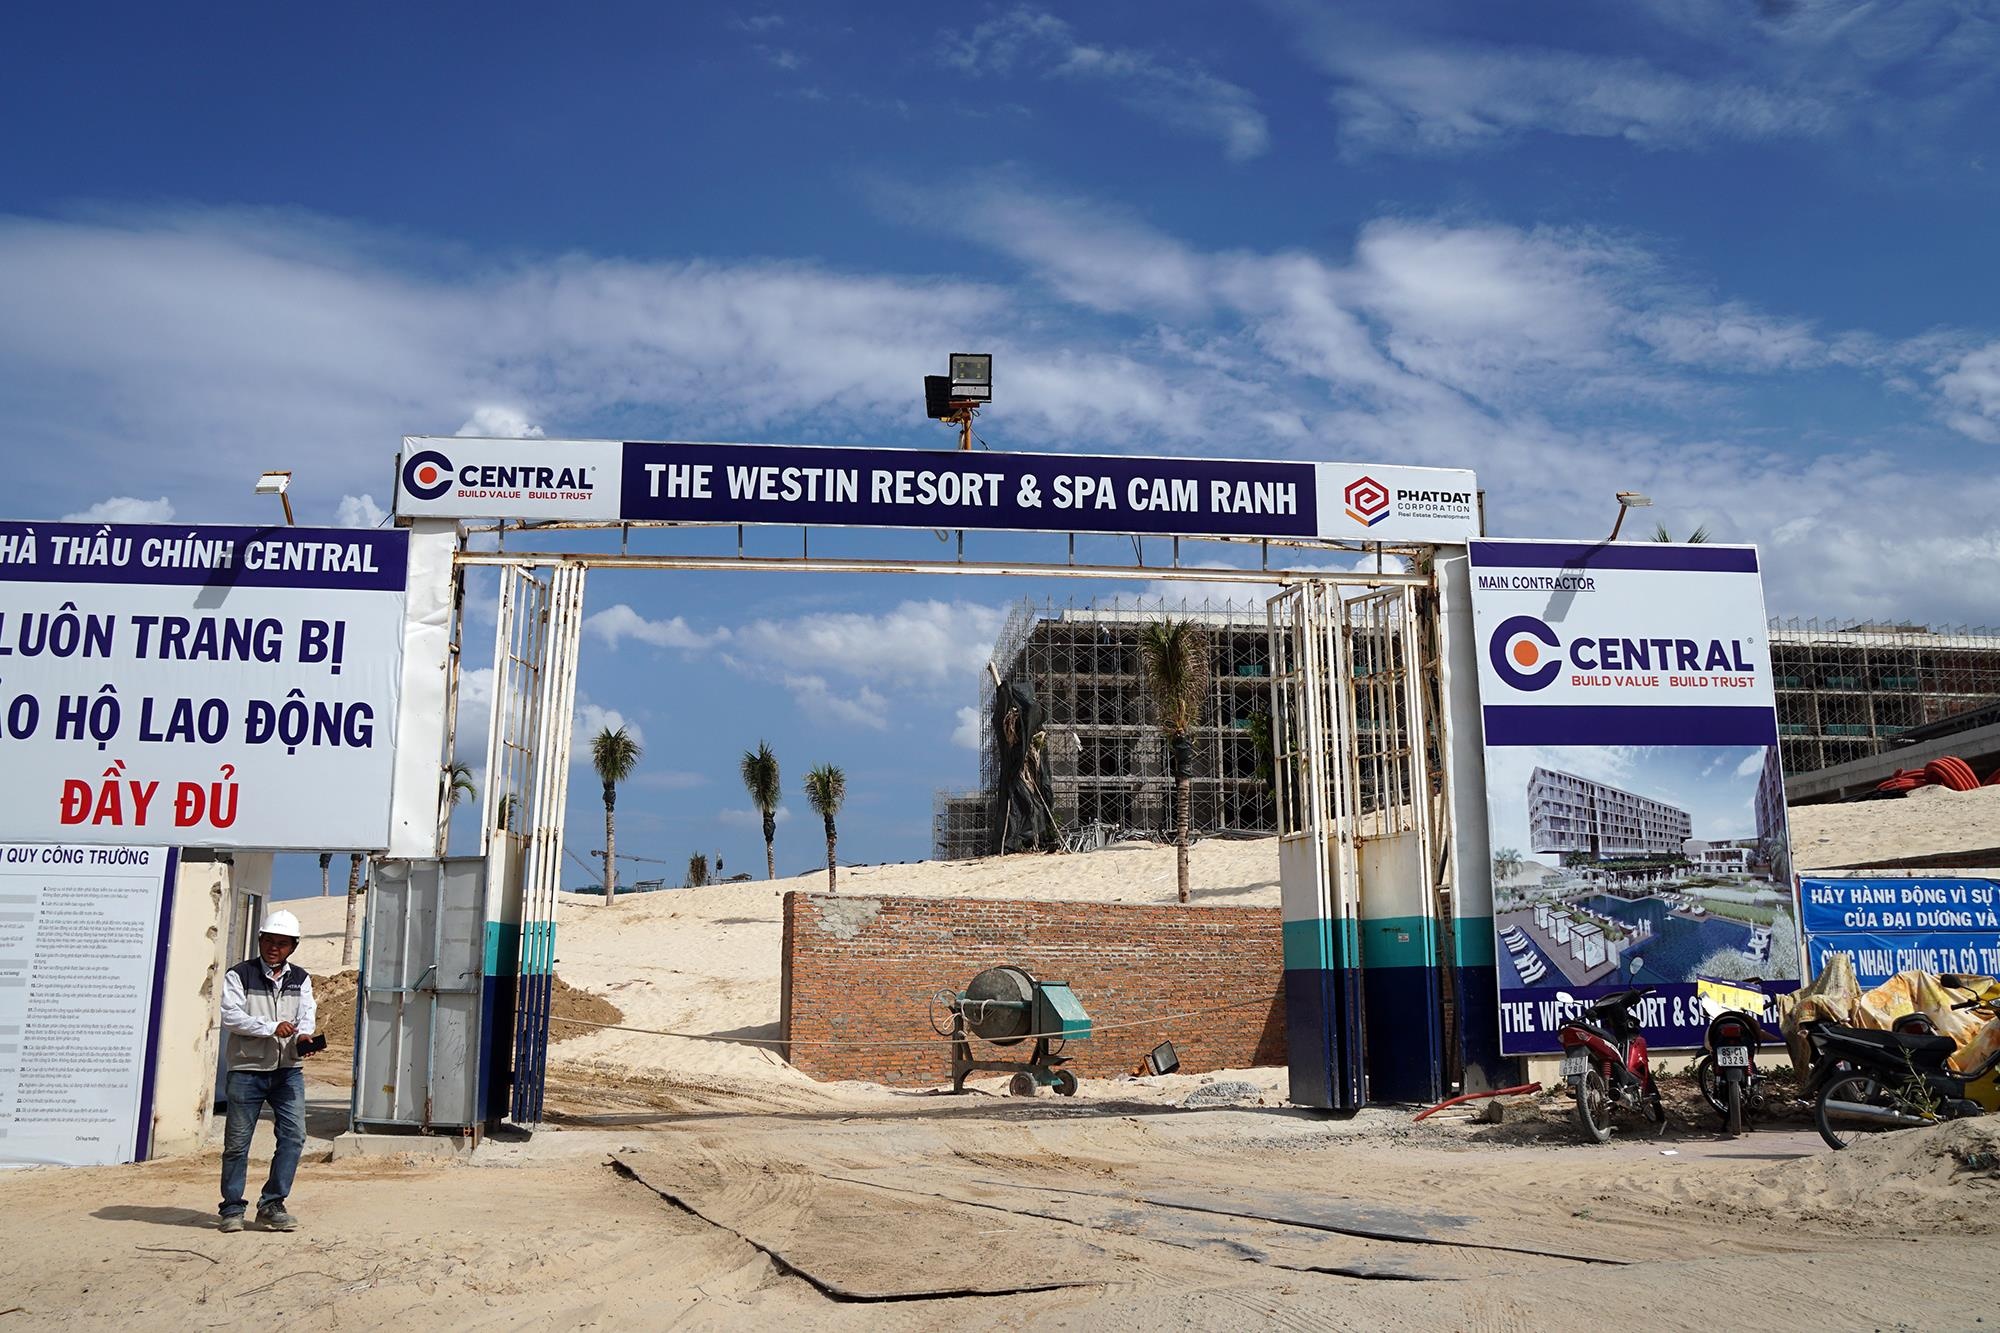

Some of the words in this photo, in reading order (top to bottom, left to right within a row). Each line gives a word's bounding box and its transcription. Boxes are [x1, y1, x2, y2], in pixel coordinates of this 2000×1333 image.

[459, 465, 593, 489] CENTRAL
[645, 463, 713, 498] THE
[727, 466, 858, 503] WESTIN
[871, 469, 1004, 507] RESORT
[1017, 475, 1042, 508] &
[1052, 475, 1117, 510] SPA
[1129, 477, 1198, 512] CAM
[1211, 480, 1297, 515] RANH
[458, 490, 486, 498] BUILD
[489, 490, 520, 499] VALUE
[528, 491, 557, 500] BUILD
[560, 492, 593, 500] TRUST
[1397, 489, 1471, 504] PHATDAT
[1397, 502, 1470, 513] CORPORATION
[1433, 512, 1470, 520] Development
[51, 525, 132, 567] THẦU
[141, 532, 234, 569] CHÍNH
[245, 541, 379, 573] CENTRAL
[1478, 576, 1508, 588] MAIN
[1512, 576, 1595, 590] CONTRACTOR
[0, 601, 116, 658] LUÔN
[131, 616, 283, 663] TRANG
[298, 620, 346, 675] BỊ
[1569, 637, 1754, 671] CENTRAL
[1572, 675, 1611, 687] BUILD
[1614, 676, 1659, 687] VALUE
[1670, 676, 1708, 687] BUILD
[1713, 677, 1755, 688] TRUST
[55, 683, 121, 751] HỘ
[139, 697, 229, 744] LAO
[245, 688, 374, 755] ĐỘNG
[60, 760, 160, 826] ĐẦY
[174, 764, 239, 828] ĐỦ
[7, 848, 38, 864] QUY
[42, 845, 84, 864] CÔNG
[89, 846, 150, 865] TRƯỜNG
[1811, 885, 1844, 904] HÃY
[1850, 885, 1896, 904] HÀNH
[1901, 885, 1947, 906] ĐỘNG
[1950, 885, 1967, 904] VÌ
[1971, 886, 1994, 906] SỰ
[1844, 906, 1878, 927] CỦA
[1882, 912, 1912, 930] ĐẠI
[1916, 909, 1972, 927] DƯƠNG
[1975, 908, 1999, 927] VÀ
[1858, 949, 1893, 976] NHAU
[1896, 942, 1939, 975] CHÚNG
[1940, 948, 1958, 974] TA
[1960, 941, 1979, 974] CÓ
[1502, 1002, 1535, 1033] THE
[1673, 996, 1686, 1027] &
